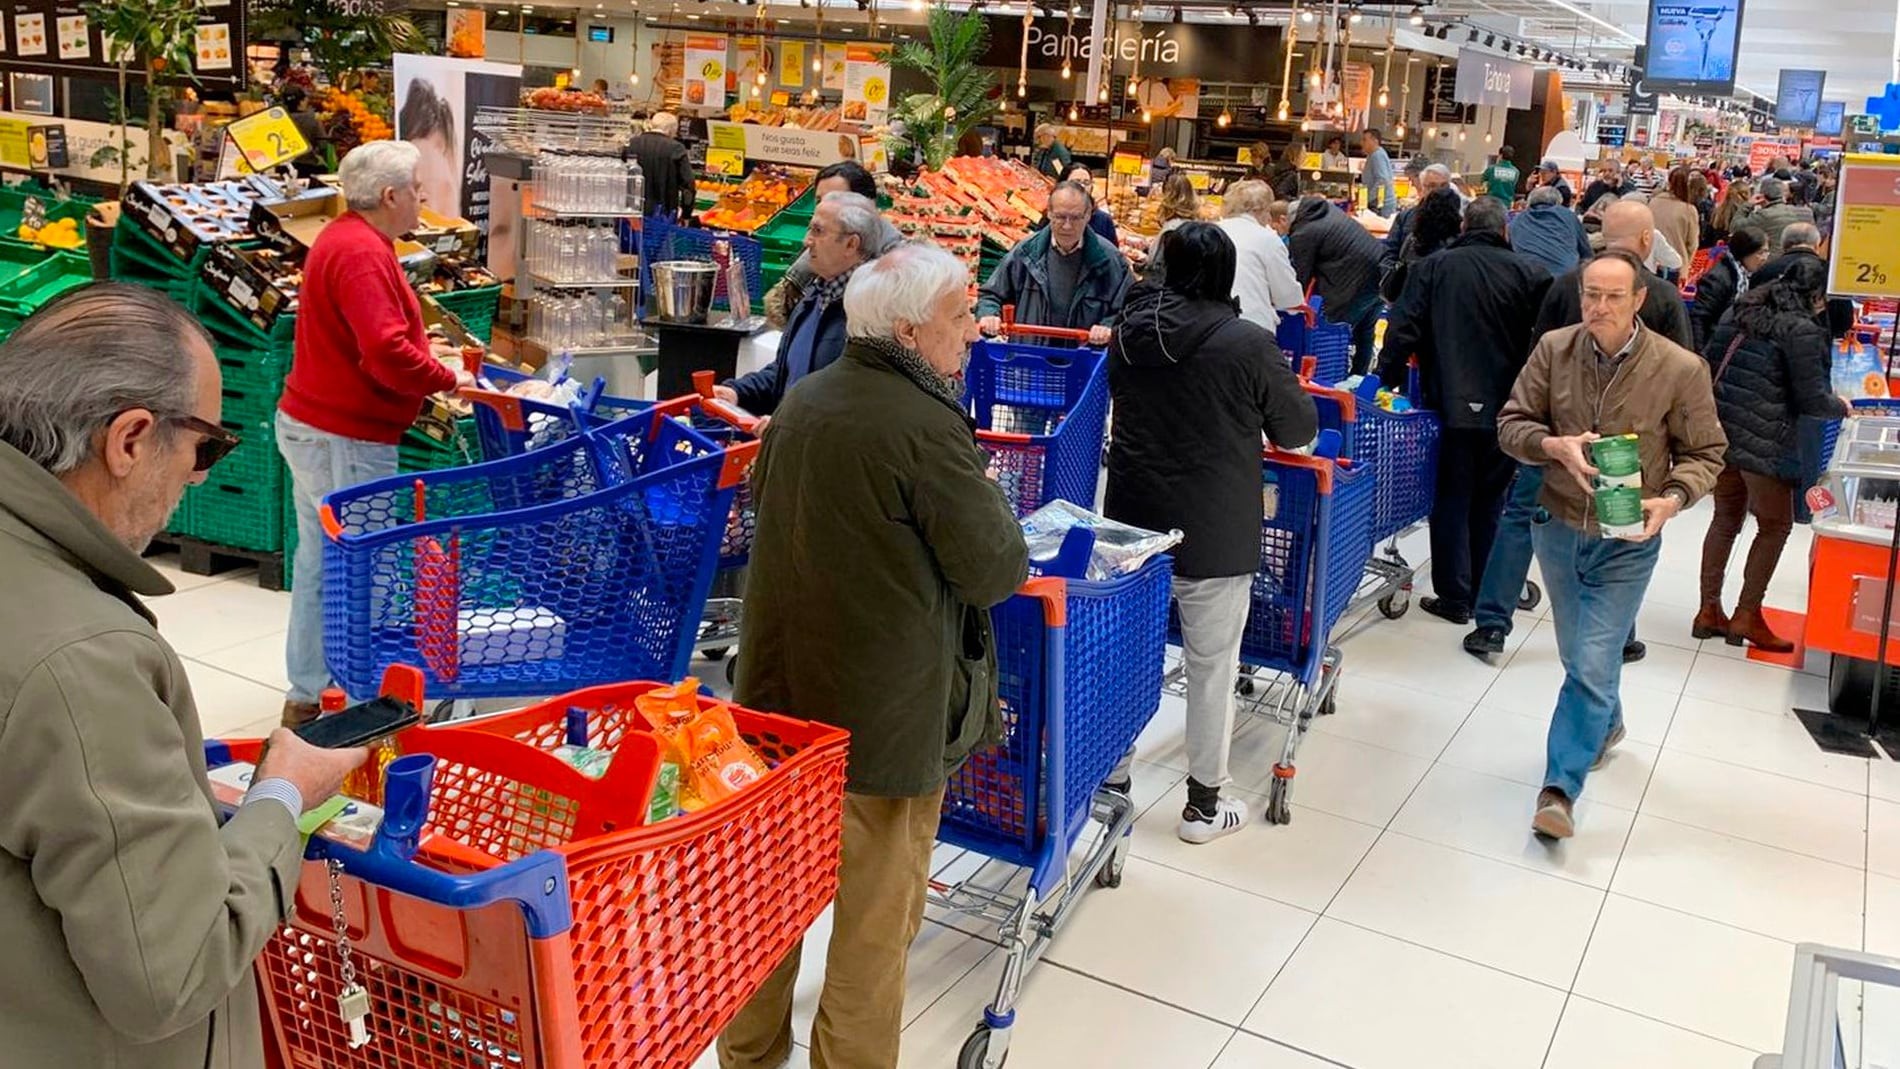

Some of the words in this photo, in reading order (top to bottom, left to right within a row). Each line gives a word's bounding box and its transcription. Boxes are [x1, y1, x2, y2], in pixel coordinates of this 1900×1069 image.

[1026, 26, 1179, 63] Panadería
[762, 133, 779, 143] Nos
[780, 136, 806, 145] gusta
[763, 145, 779, 153] que
[781, 147, 801, 155] seas
[802, 147, 821, 157] feliz
